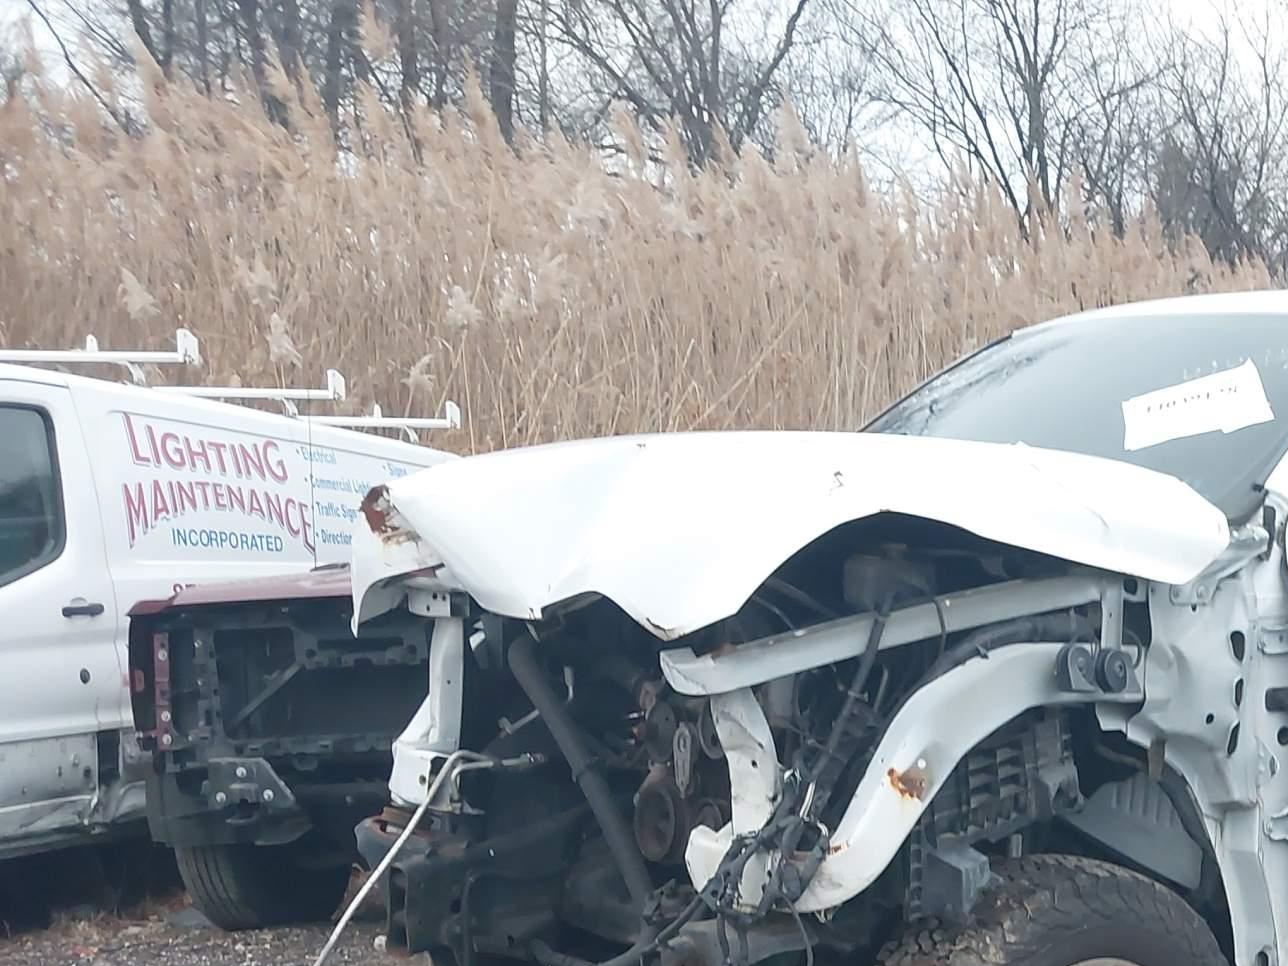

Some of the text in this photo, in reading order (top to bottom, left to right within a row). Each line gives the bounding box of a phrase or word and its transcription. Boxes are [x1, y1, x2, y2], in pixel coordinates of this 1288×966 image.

[122, 411, 289, 485] LIGHTING
[121, 479, 316, 555] MAINTENANCE
[171, 527, 284, 553] INCORPORATED
